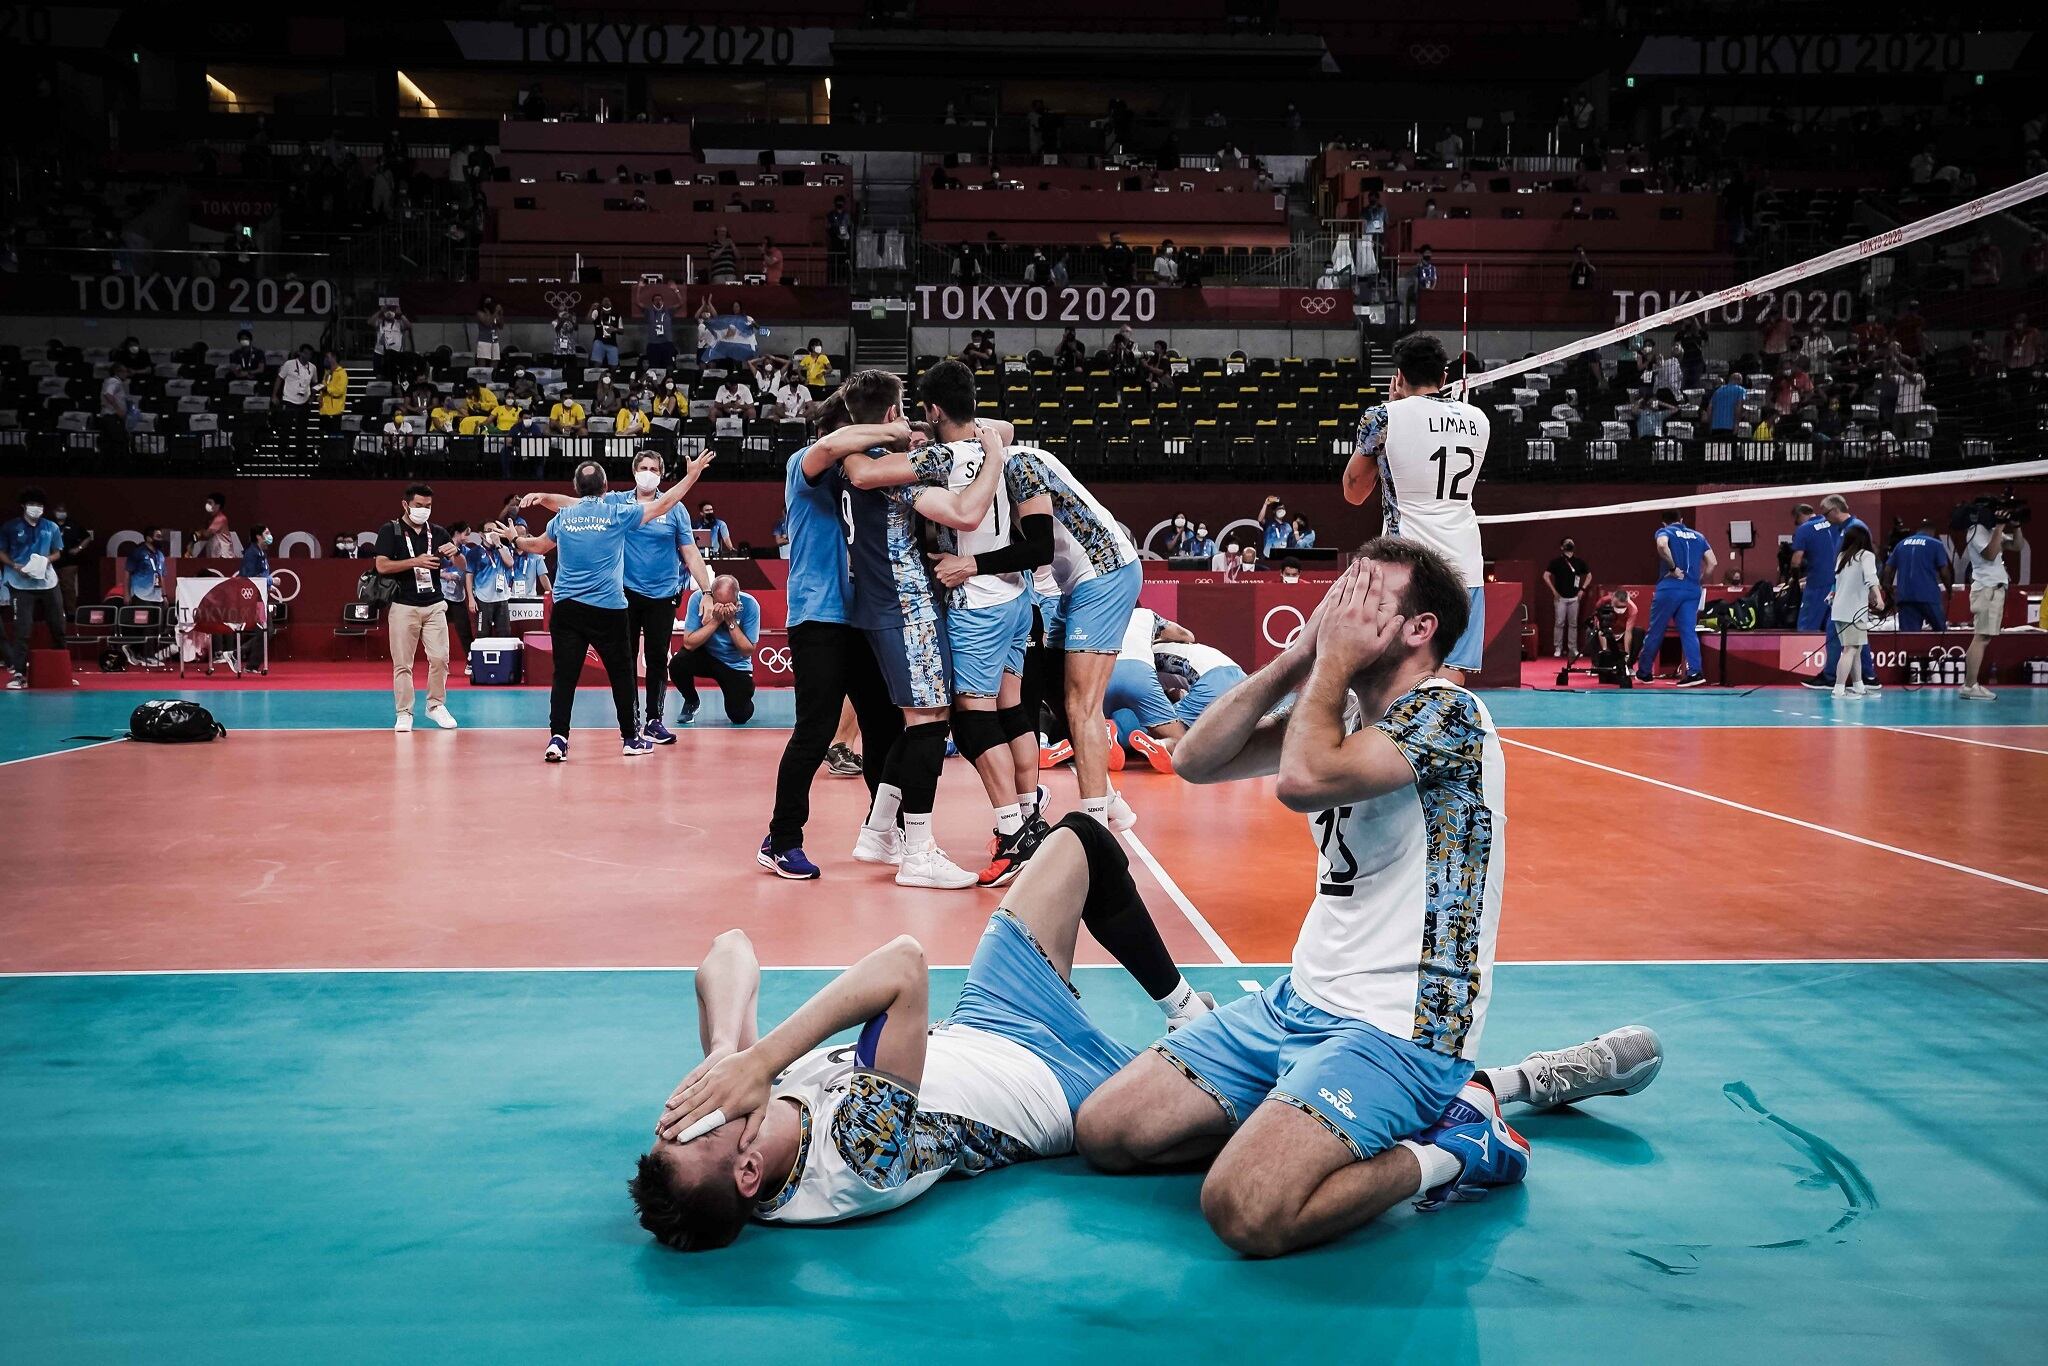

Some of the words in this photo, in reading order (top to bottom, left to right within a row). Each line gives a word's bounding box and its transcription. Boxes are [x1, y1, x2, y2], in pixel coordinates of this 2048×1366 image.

[515, 22, 668, 64] TOKYO
[683, 25, 794, 66] 2020
[1692, 32, 1841, 76] TOKYO
[1856, 31, 1965, 73] 2020
[201, 201, 251, 216] TOKYO
[253, 202, 272, 216] 20
[70, 274, 216, 312] TOKYO
[228, 277, 332, 315] 2020
[915, 285, 1049, 320] TOKYO
[1060, 287, 1156, 322] 2020
[1756, 288, 1853, 325] 2020
[1429, 417, 1467, 434] LIMA
[1469, 420, 1479, 436] B.
[1429, 446, 1475, 501] 12
[511, 610, 533, 618] OKYO
[1314, 806, 1358, 884] 15
